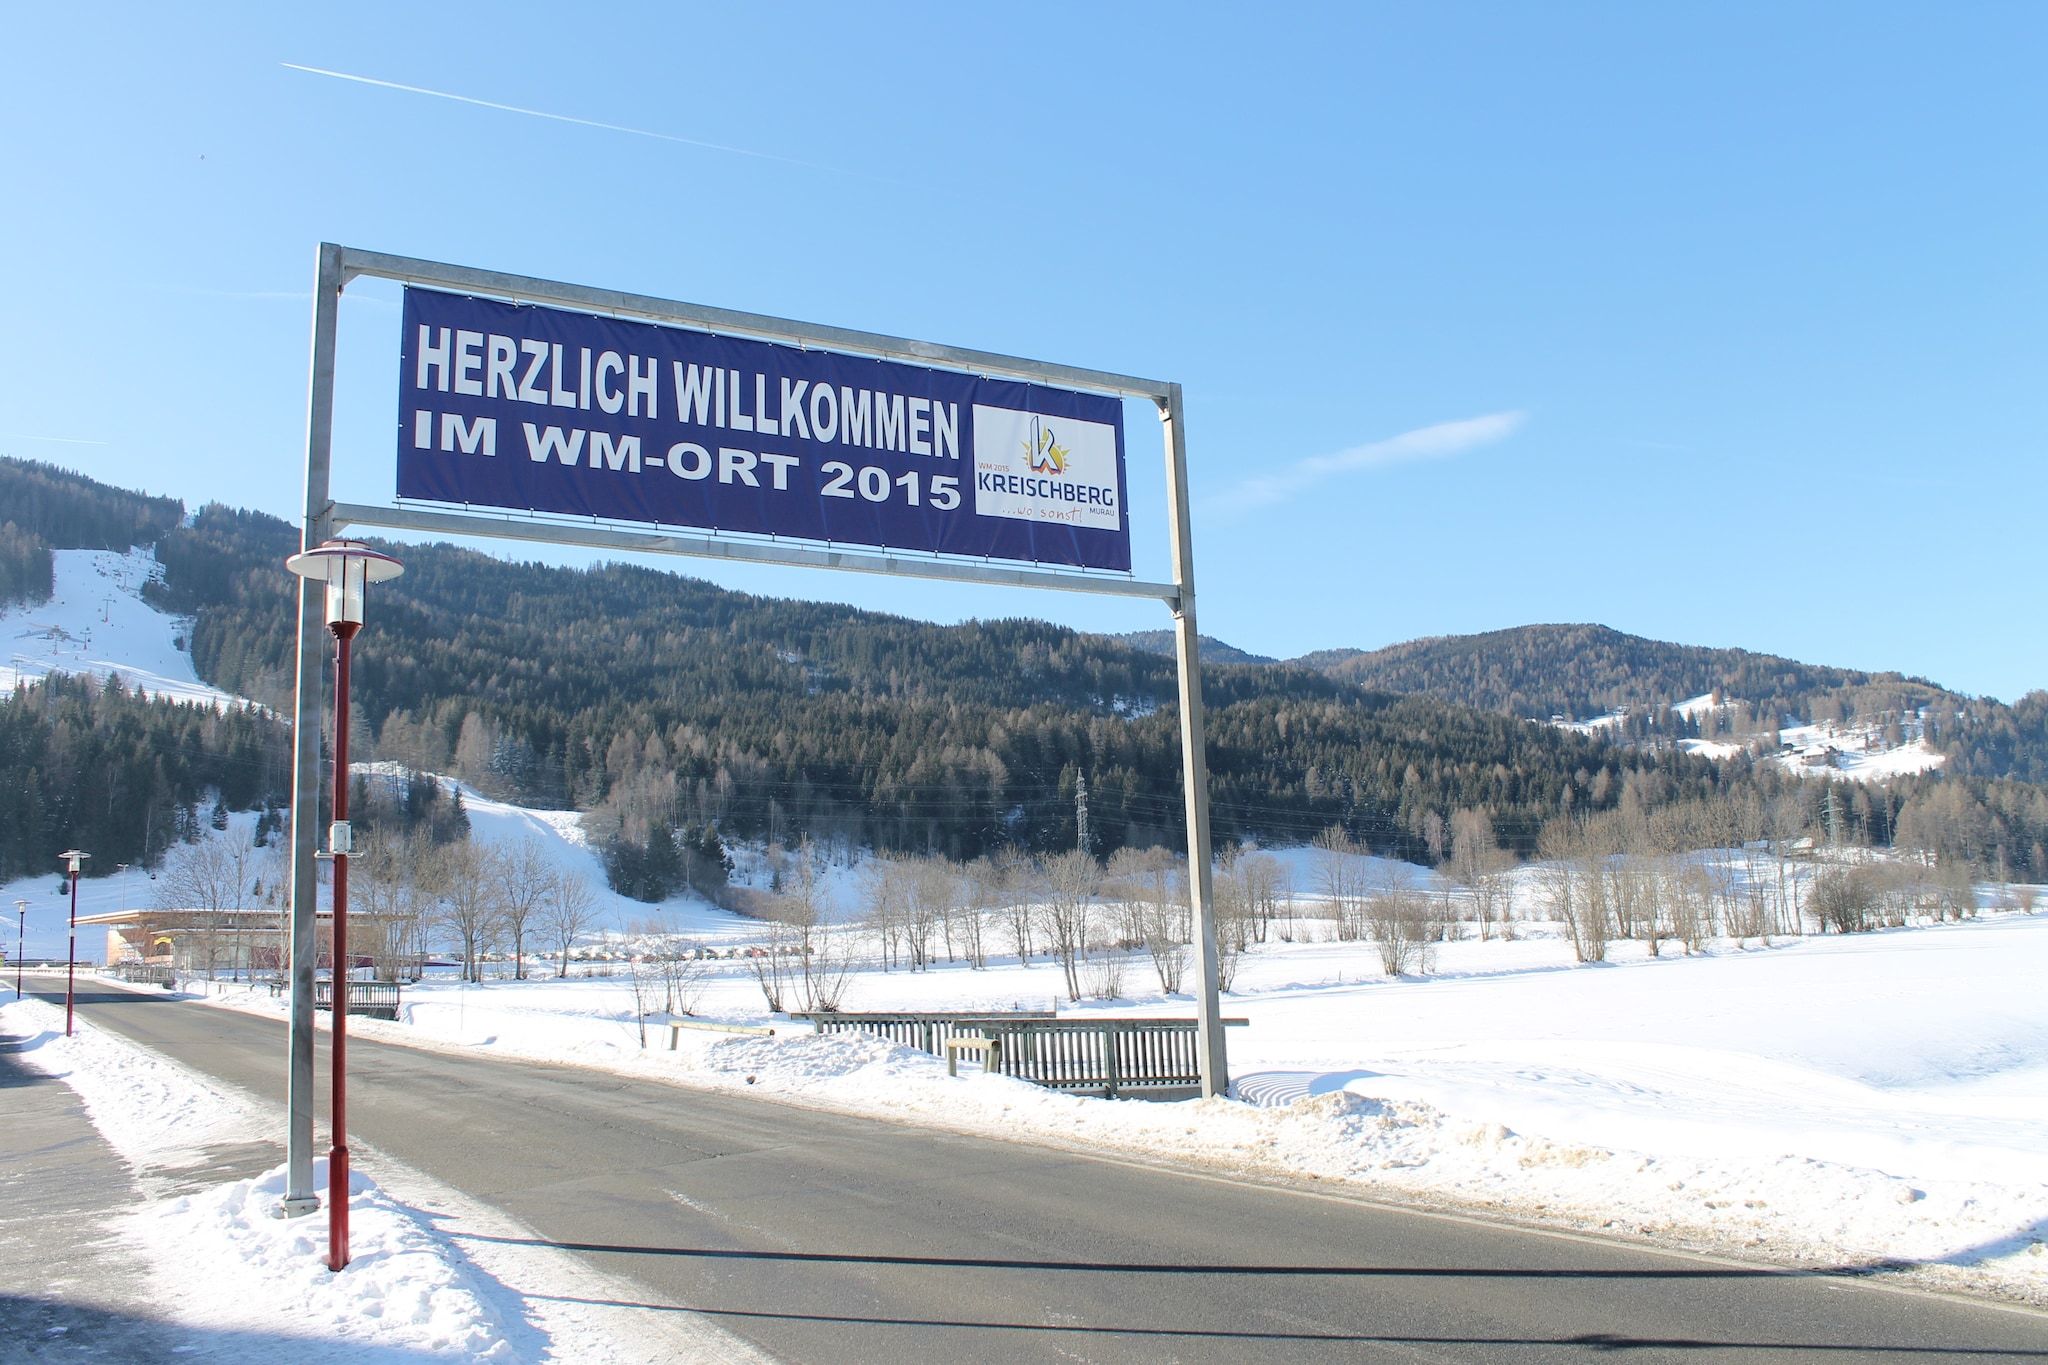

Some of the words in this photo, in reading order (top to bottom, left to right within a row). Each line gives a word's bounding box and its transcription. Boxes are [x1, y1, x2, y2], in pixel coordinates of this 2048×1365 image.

[416, 324, 658, 420] HERZLICH
[673, 361, 960, 460] WILLKOMMEN
[414, 409, 497, 457] IM
[522, 422, 800, 491] WM-ORT
[820, 461, 962, 511] 2015
[978, 472, 1113, 506] KREISCHBERG
[1089, 507, 1115, 517] MURAU
